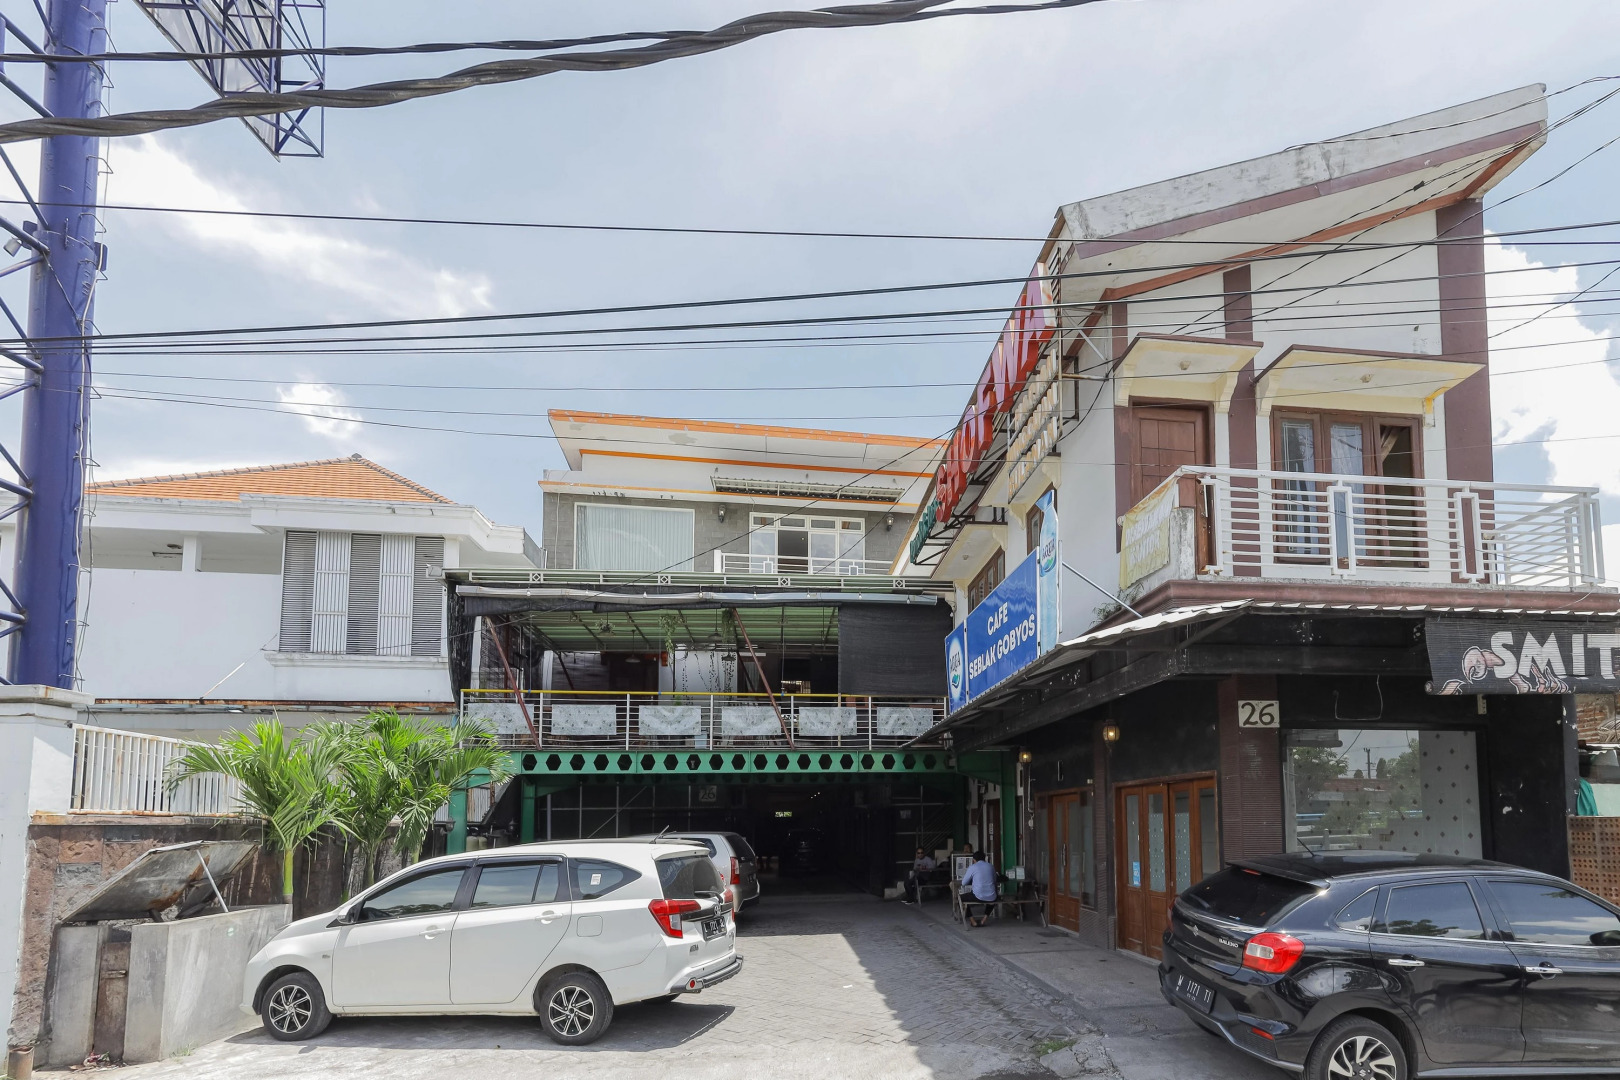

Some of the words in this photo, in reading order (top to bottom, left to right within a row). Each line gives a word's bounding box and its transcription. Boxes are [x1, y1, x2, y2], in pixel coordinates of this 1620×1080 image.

[936, 262, 1056, 523] SHOFWA
[1042, 539, 1055, 561] AQUA
[988, 602, 1008, 636] CAFE
[969, 644, 996, 679] SEBLAK
[997, 614, 1036, 660] GOBYOS
[1241, 702, 1275, 726] 26
[701, 787, 715, 800] 26
